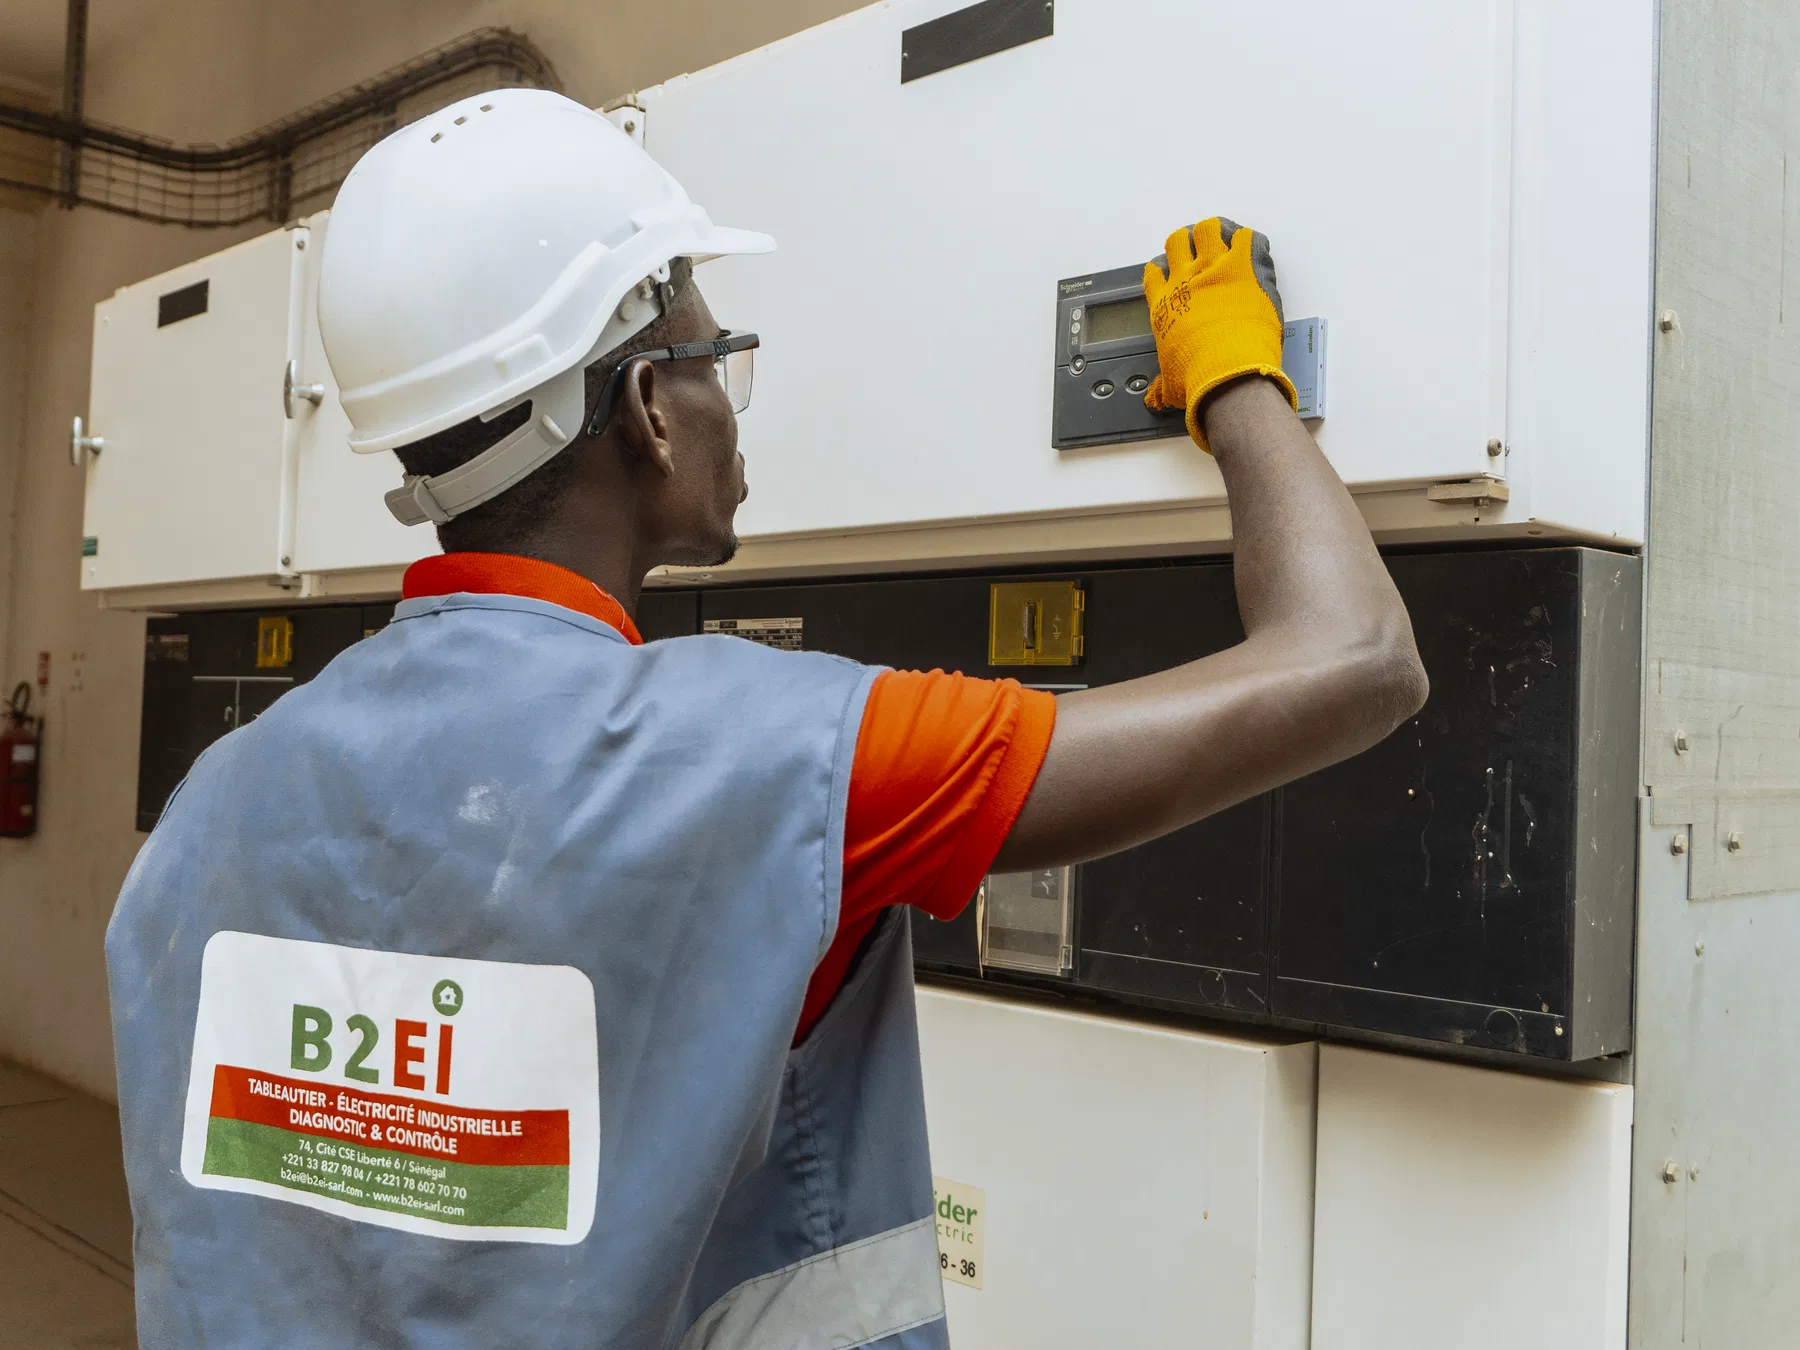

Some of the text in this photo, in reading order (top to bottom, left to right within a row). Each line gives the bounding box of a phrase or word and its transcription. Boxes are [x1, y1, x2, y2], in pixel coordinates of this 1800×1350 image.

[248, 1078, 327, 1108] TABLEAUTIER
[337, 1092, 415, 1124] ÉLECTRICITÉ
[417, 1109, 523, 1136] INDUSTRIELLE
[289, 1108, 458, 1154] DIAGNOSTIC & CONTRÔLE
[282, 1153, 467, 1199] +221 33 827 98 04 / +221 78 602 70 70
[299, 1139, 447, 1180] 74, Cité CSE Liberté 6 / Sénégal
[280, 1166, 363, 1198] b2ei@b2ei-sarl.com
[372, 1192, 465, 1216] www.b2ei-sarl.com
[936, 1223, 973, 1244] ctric
[960, 1258, 976, 1278] 36
